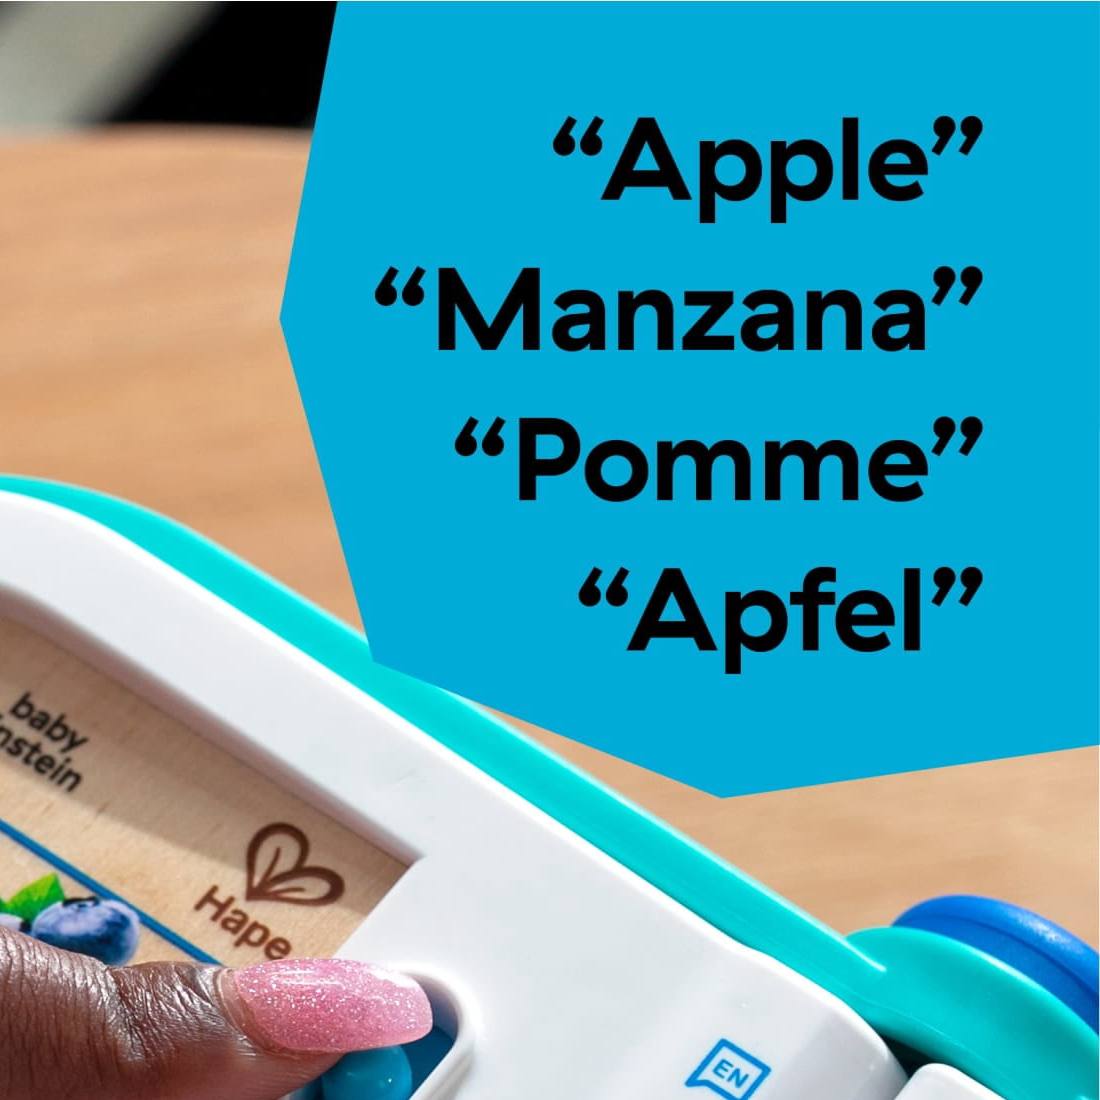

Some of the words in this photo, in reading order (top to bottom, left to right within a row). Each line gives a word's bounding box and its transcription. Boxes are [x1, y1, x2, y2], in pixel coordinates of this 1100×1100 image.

[9, 692, 89, 750] baby
[194, 885, 293, 960] Hape
[712, 1058, 749, 1089] EN
